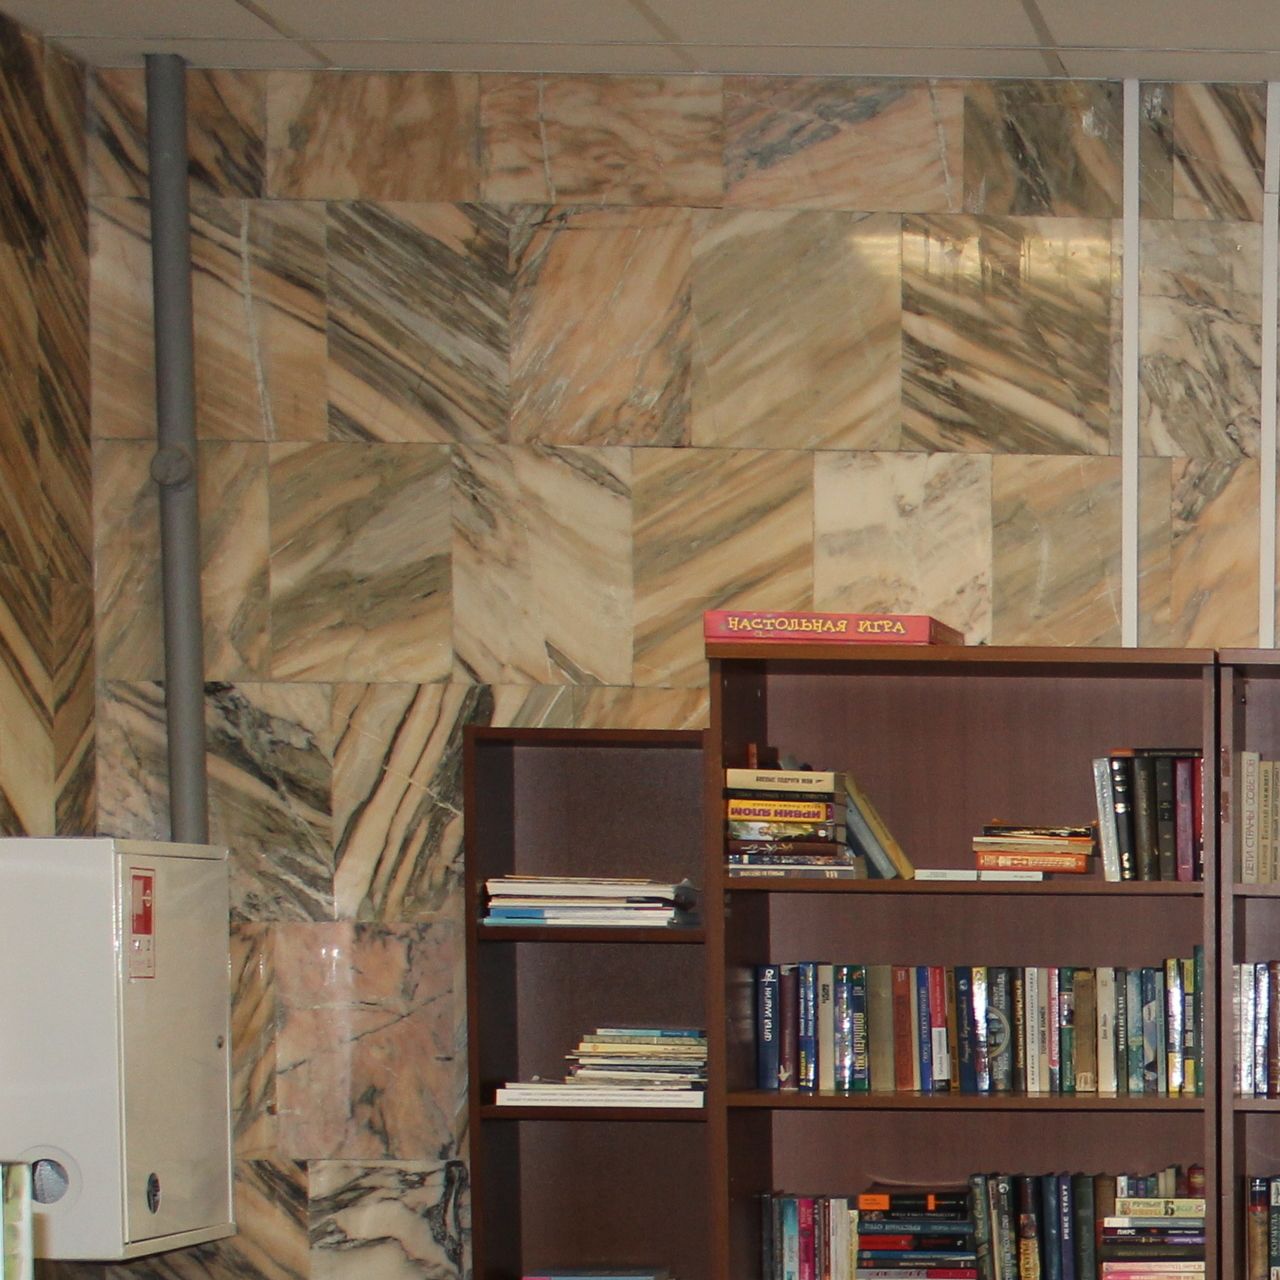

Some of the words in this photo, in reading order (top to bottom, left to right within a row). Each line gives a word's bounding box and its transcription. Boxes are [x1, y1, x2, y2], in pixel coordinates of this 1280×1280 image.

[727, 616, 848, 634] НАСТОЛЬНАЯ
[856, 619, 906, 635] ИГРА
[1245, 759, 1256, 806] СОВЕТОВ
[730, 807, 771, 818] ЯЛОМ
[774, 808, 821, 819] ИРВИН
[1244, 810, 1256, 848] СТРАНЫ
[1244, 850, 1256, 877] ДЕТИ
